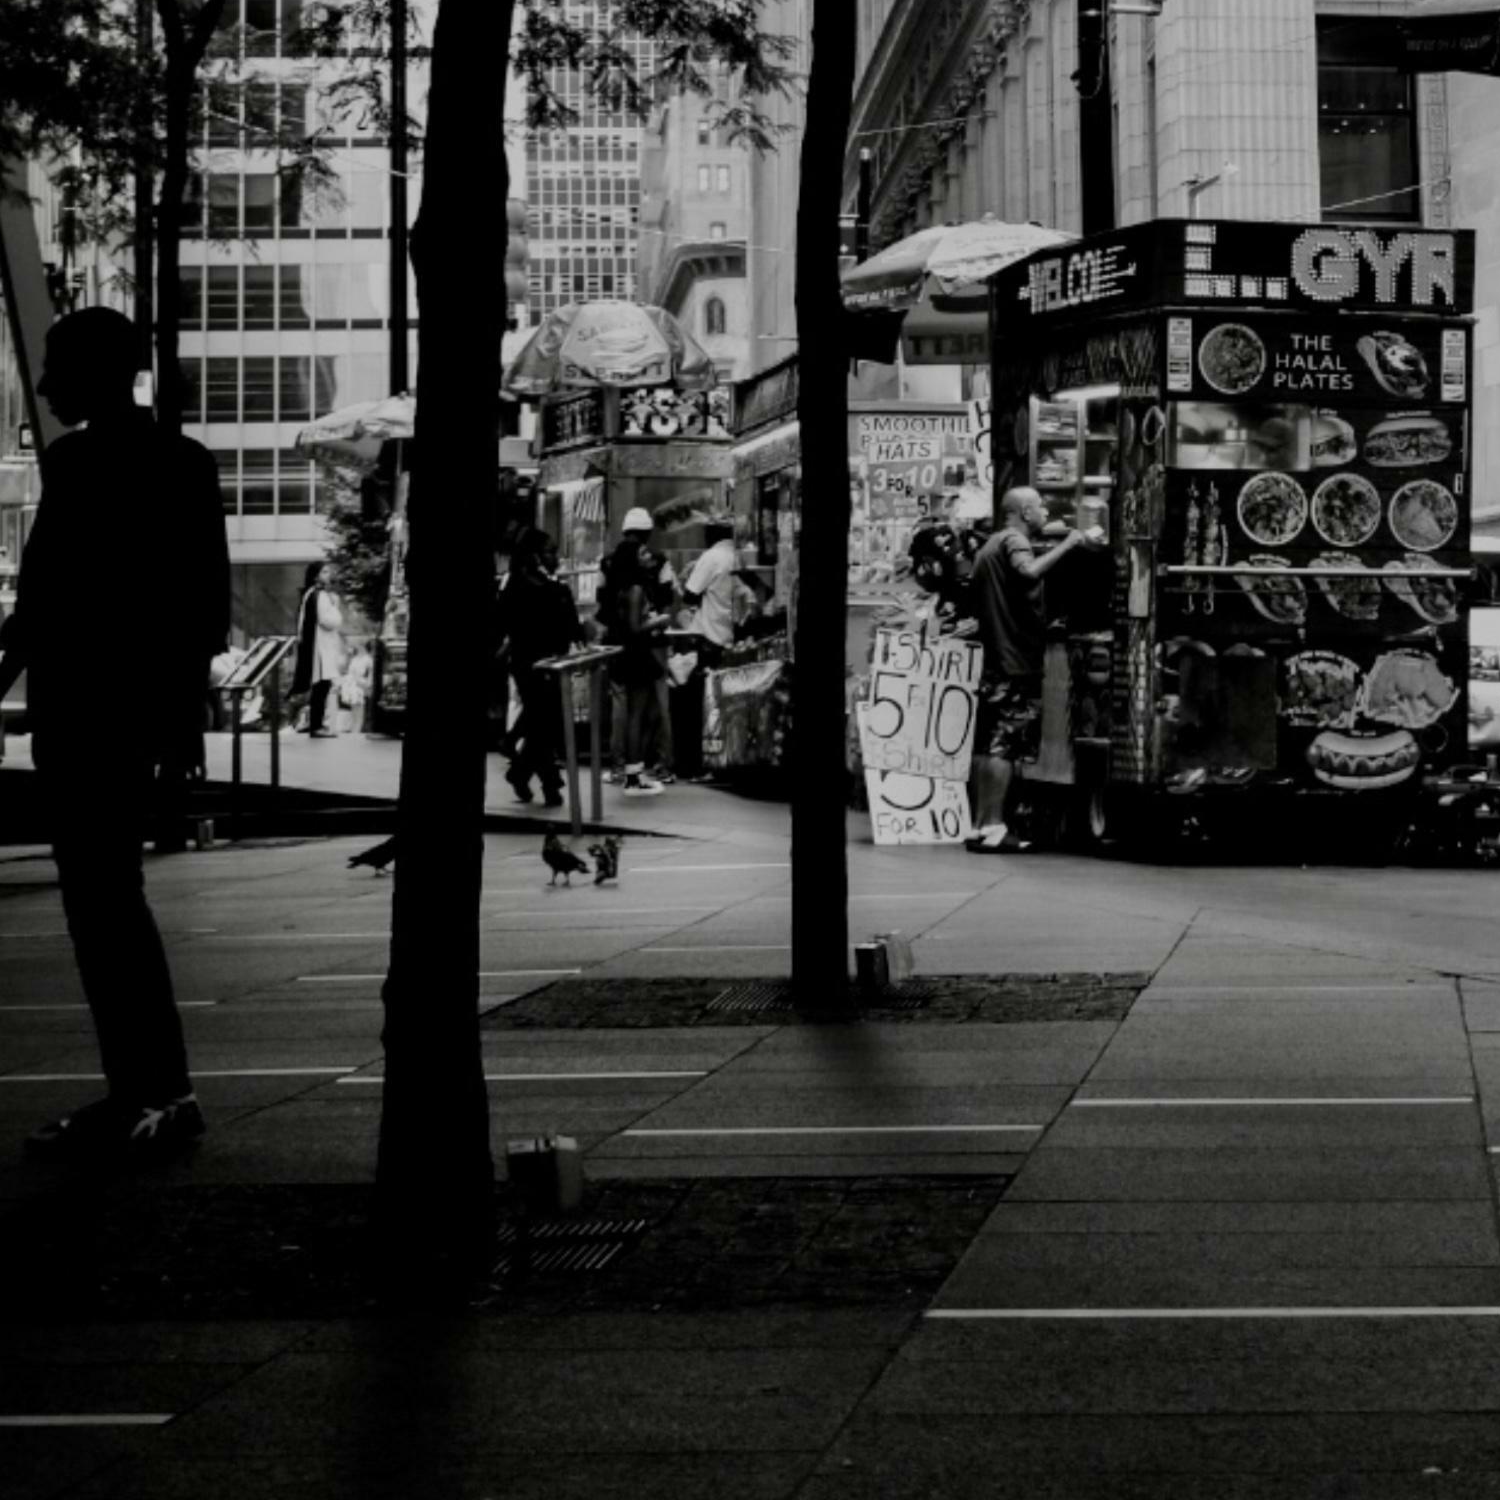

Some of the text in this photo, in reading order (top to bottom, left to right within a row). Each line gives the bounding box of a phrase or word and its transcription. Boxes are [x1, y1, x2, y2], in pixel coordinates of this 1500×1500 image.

[1290, 332, 1333, 351] THE
[1275, 352, 1348, 371] HALAL
[1273, 371, 1355, 391] PLATES
[924, 681, 972, 756] 10
[876, 812, 923, 838] FOR
